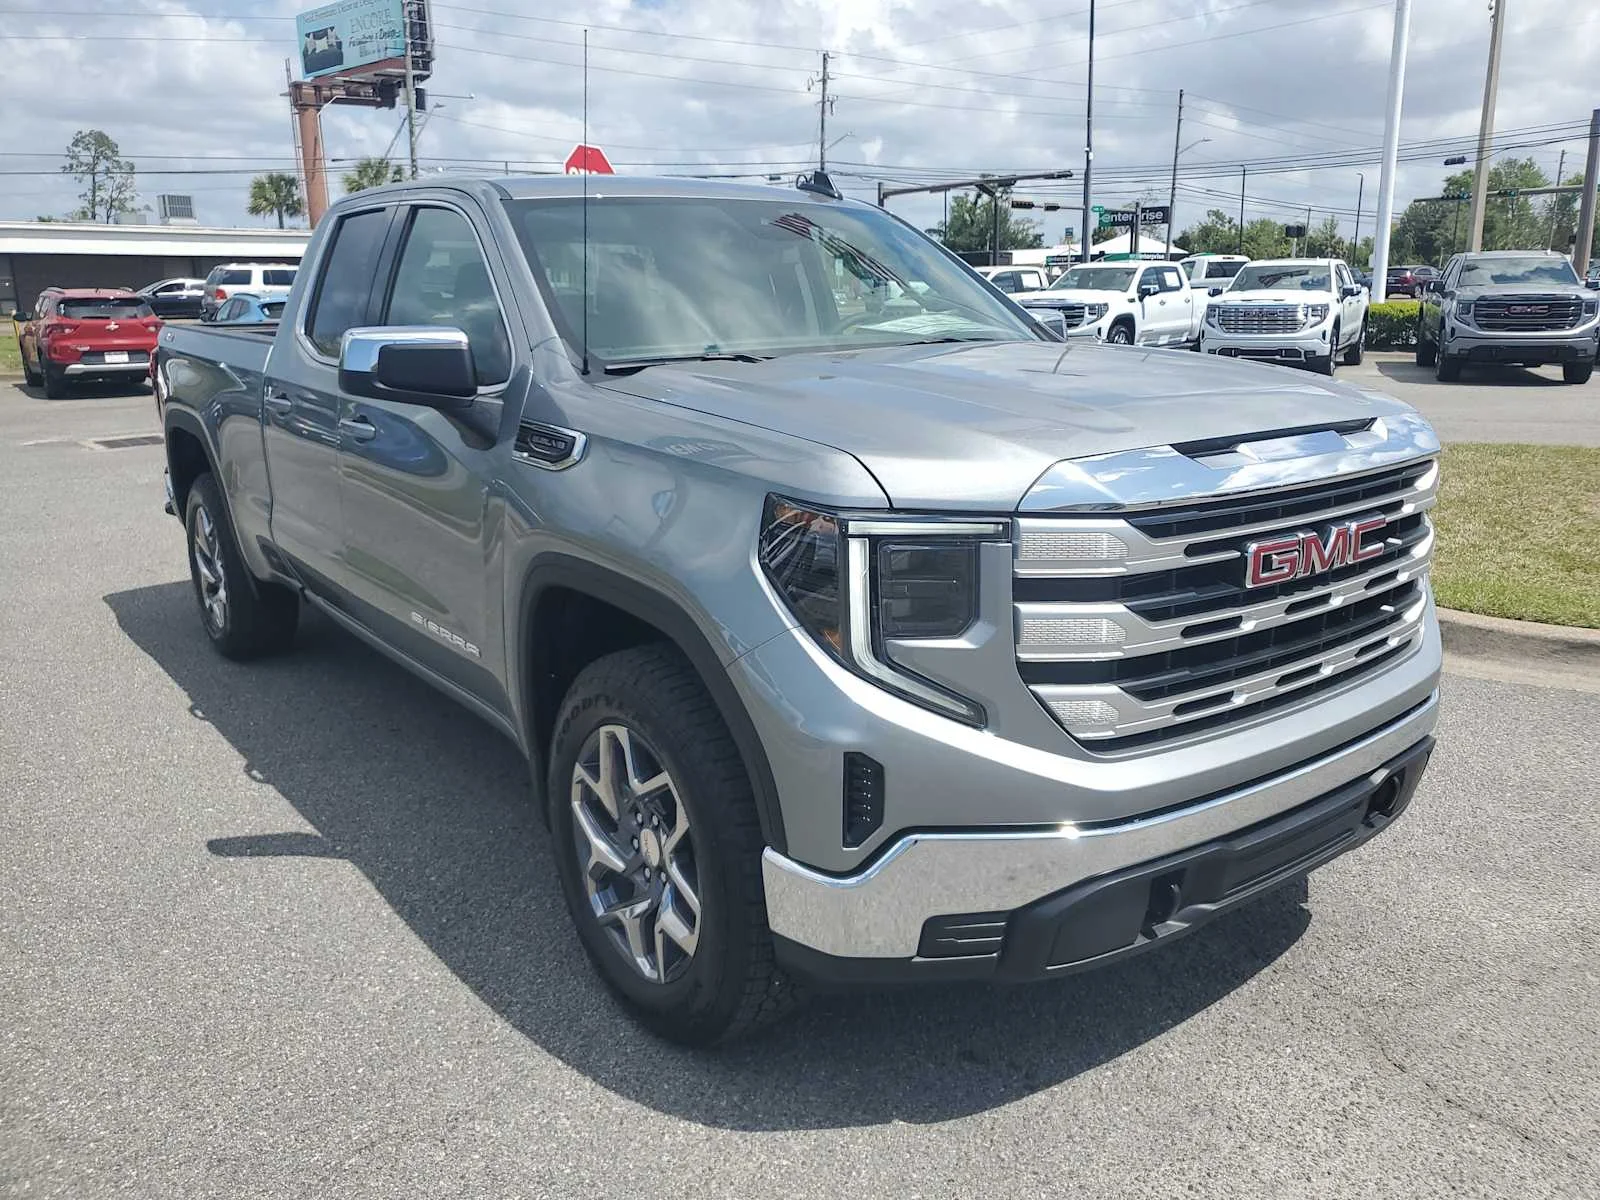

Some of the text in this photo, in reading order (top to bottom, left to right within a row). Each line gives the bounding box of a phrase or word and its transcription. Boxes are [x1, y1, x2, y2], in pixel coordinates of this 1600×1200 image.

[1101, 209, 1164, 223] enterrise
[1246, 512, 1387, 588] GMC
[411, 611, 481, 657] SIERRA
